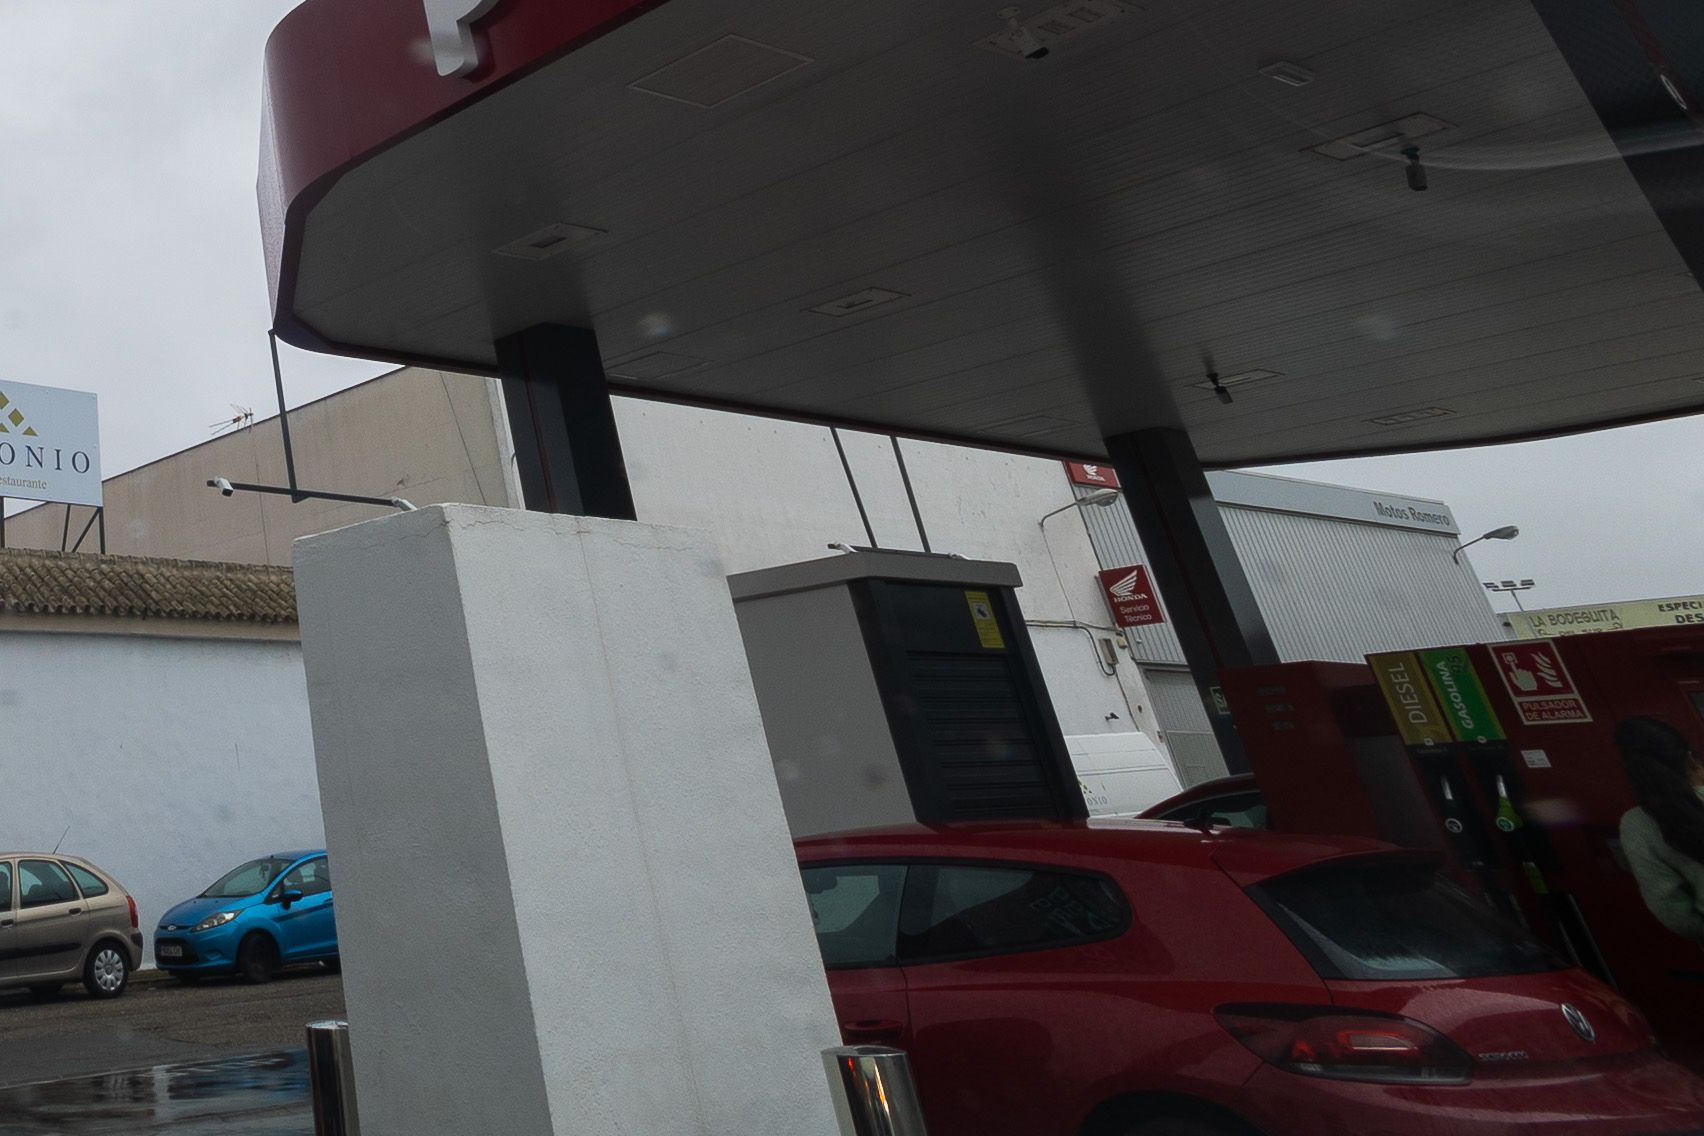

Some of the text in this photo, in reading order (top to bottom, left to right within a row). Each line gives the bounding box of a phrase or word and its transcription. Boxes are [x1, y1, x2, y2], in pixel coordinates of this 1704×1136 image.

[1373, 500, 1451, 526] Motos Romero
[1113, 593, 1148, 604] HONDA
[1120, 604, 1150, 614] Servicio
[1657, 600, 1704, 612] ESPECI
[1528, 608, 1620, 628] LA BODEGUITA
[1388, 661, 1428, 724] DIESEL
[1435, 661, 1474, 730] GASOLINA
[1522, 698, 1578, 712] PULSADOR
[1525, 708, 1587, 721] DE ALARMA
